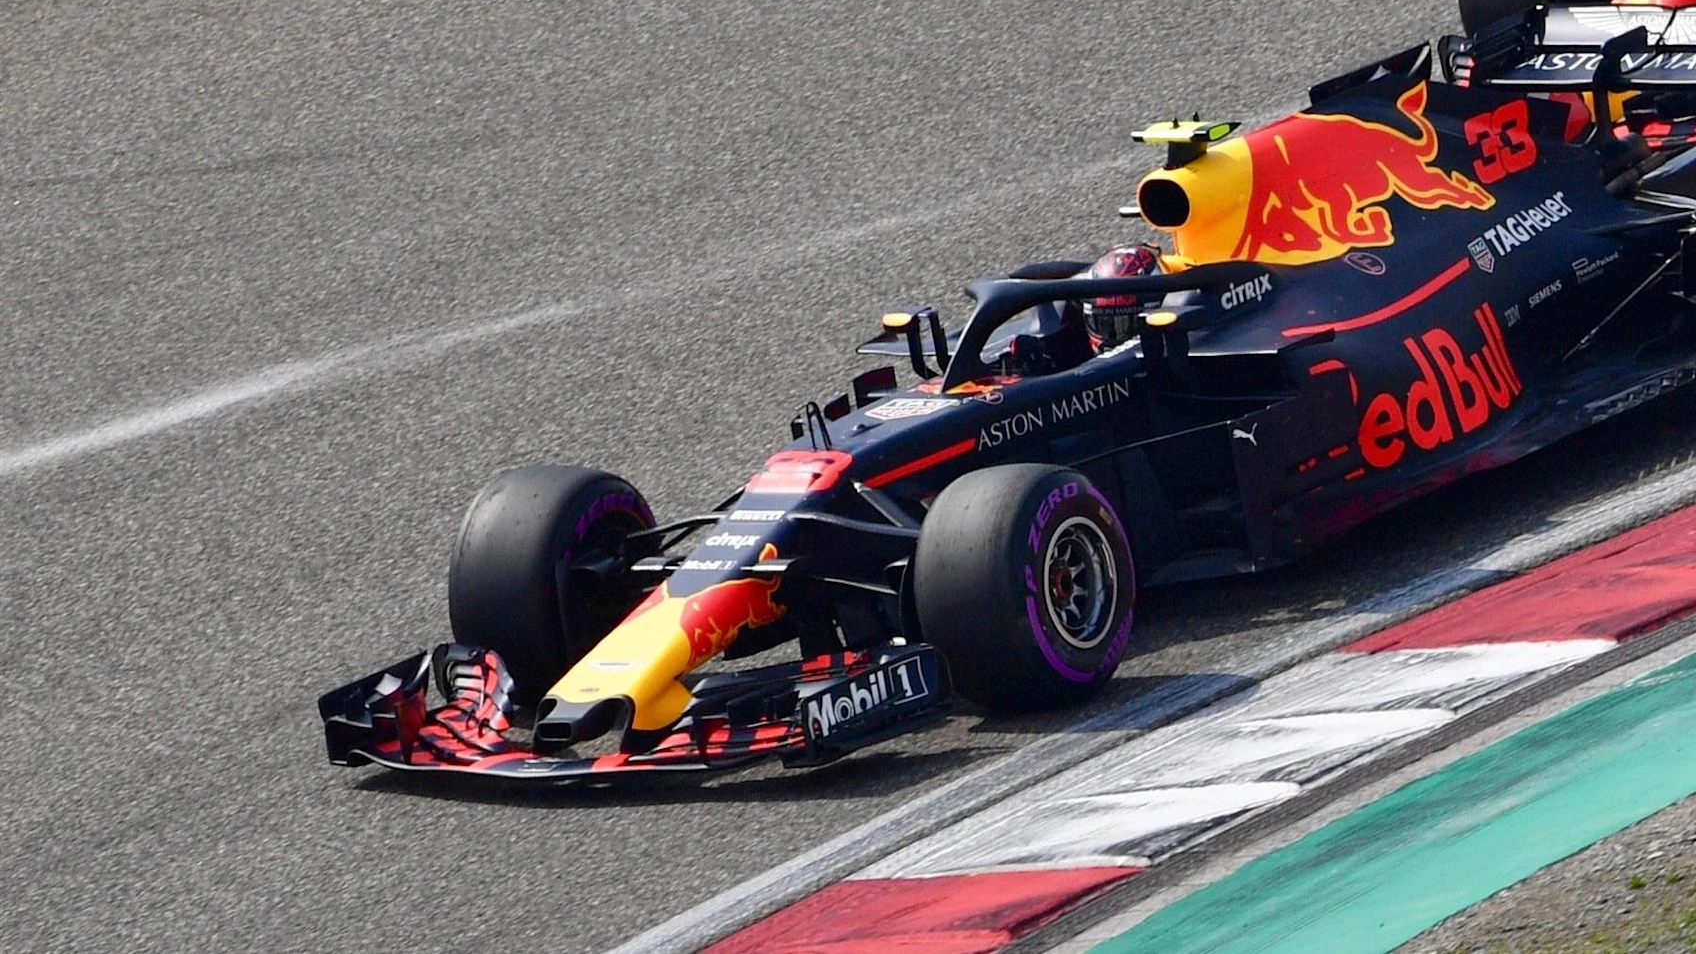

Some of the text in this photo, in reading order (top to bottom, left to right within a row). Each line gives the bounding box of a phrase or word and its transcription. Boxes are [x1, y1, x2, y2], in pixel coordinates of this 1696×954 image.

[1464, 99, 1537, 184] 33
[1529, 279, 1563, 308] SIEMENS
[978, 378, 1130, 451] ASTON MARTIN
[1028, 482, 1078, 554] ZERO
[808, 670, 888, 740] Mobil
